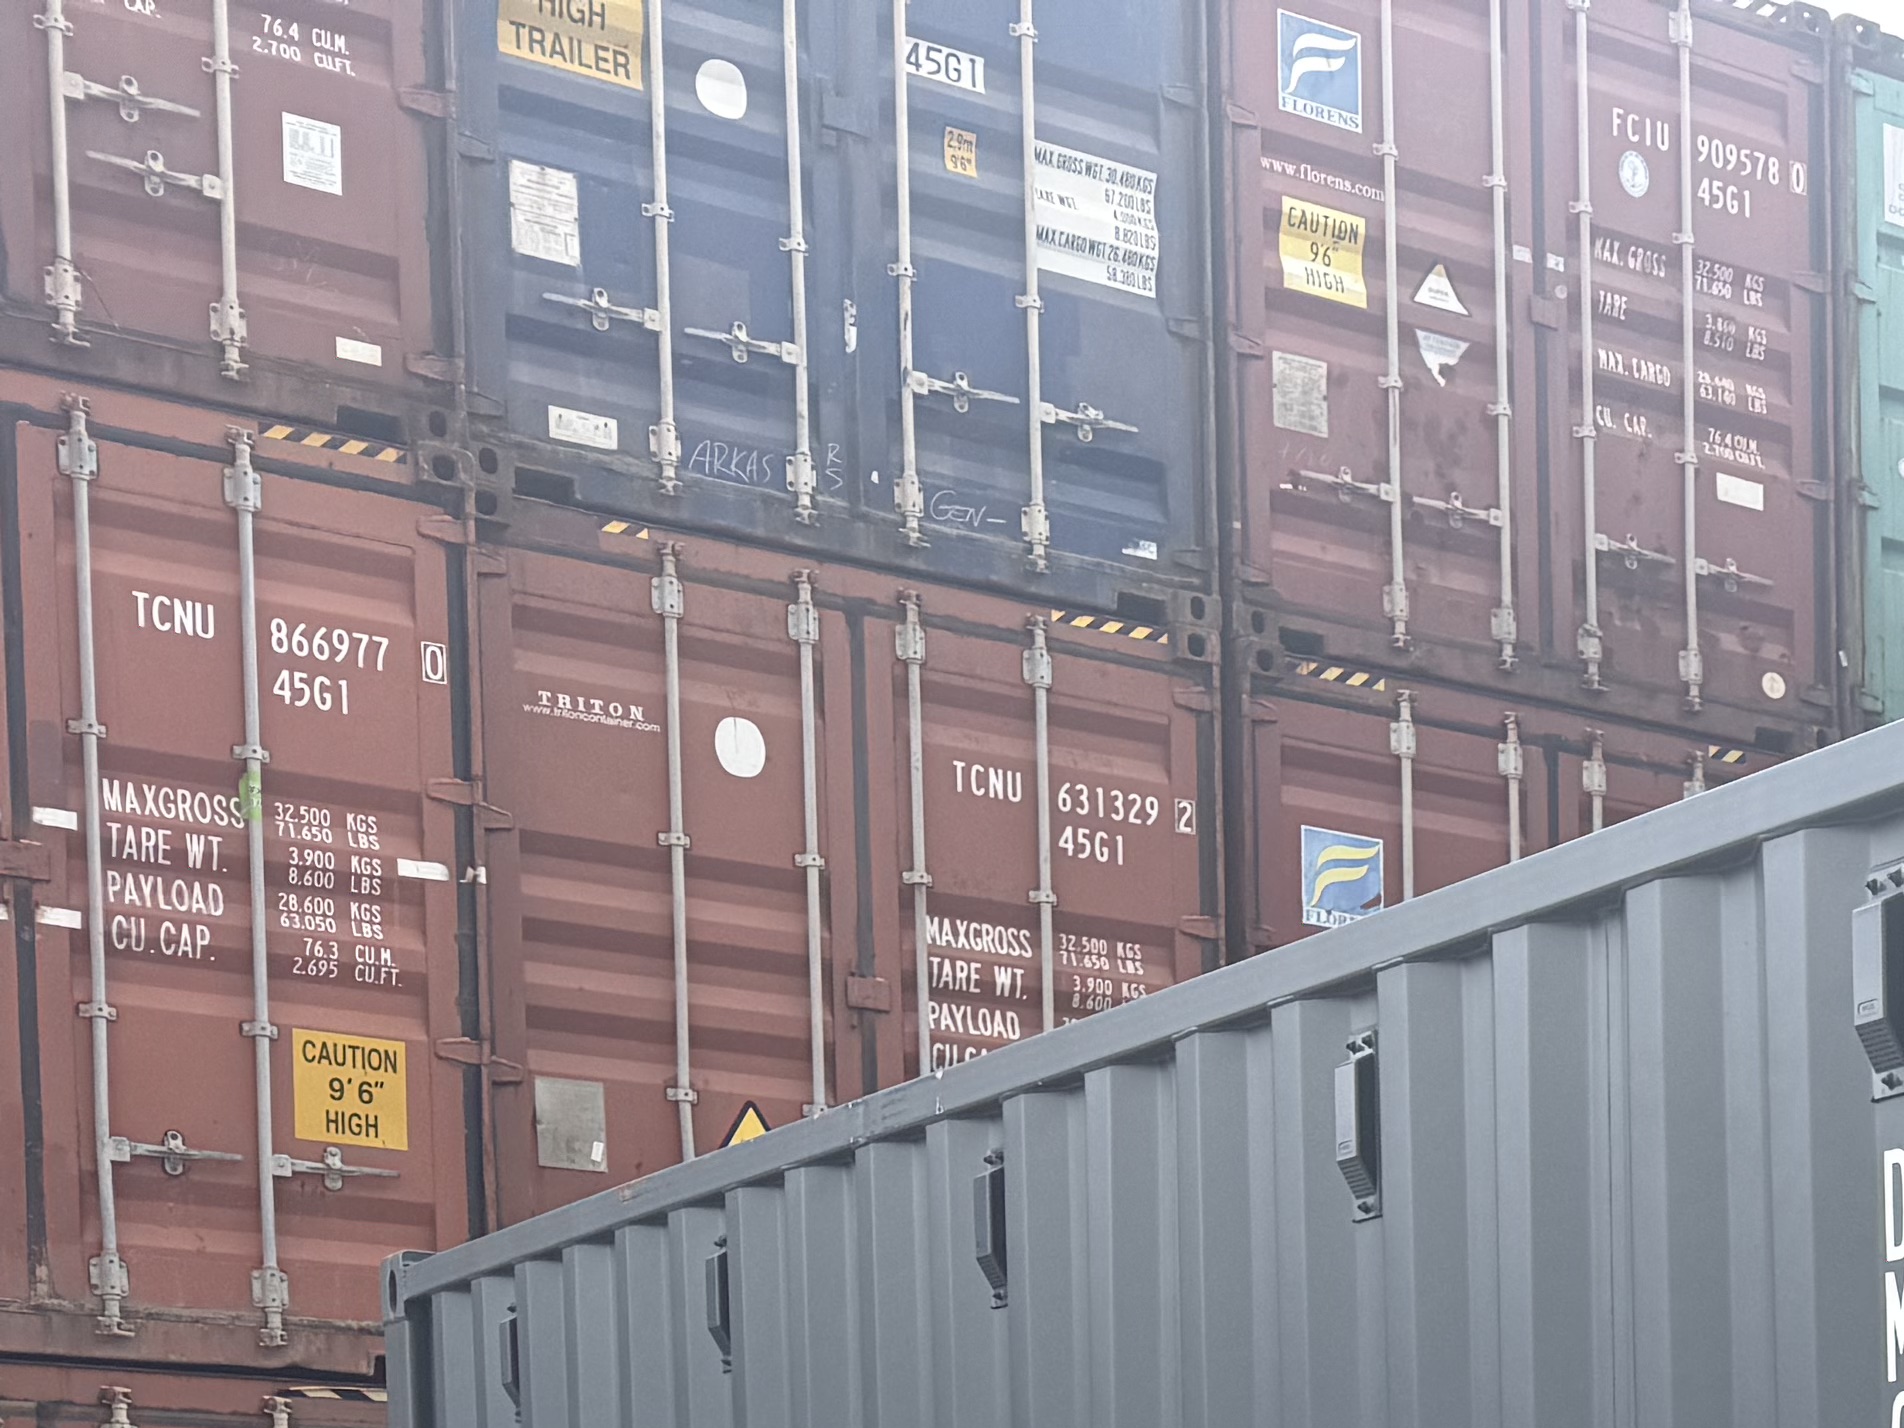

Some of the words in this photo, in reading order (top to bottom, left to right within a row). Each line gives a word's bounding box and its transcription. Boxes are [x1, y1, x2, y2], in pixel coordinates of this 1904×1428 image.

[261, 14, 299, 41] 76.4
[252, 36, 301, 61] 2.700
[509, 20, 632, 80] TRAILER
[906, 42, 977, 88] 45G1
[1281, 95, 1359, 130] FLORENS
[1612, 107, 1669, 151] FCIU
[1260, 156, 1384, 202] www.florens.com
[1697, 135, 1779, 185] 909578
[1792, 162, 1805, 194] 0
[1697, 178, 1750, 218] 45G1
[1287, 206, 1359, 245] CAUTION
[1305, 267, 1345, 293] HIGH
[1628, 247, 1666, 277] GROSS
[1599, 290, 1627, 320] TARE
[1632, 357, 1671, 387] CARGO
[688, 440, 774, 482] ARKAS
[132, 591, 215, 639] TCNU
[270, 618, 389, 671] 866977
[423, 643, 445, 682] 0
[273, 670, 348, 714] 45G1
[538, 690, 655, 721] TRITON
[953, 760, 1022, 802] TCNU
[102, 778, 245, 829] MAXGROSS
[274, 802, 331, 827] 32.500
[347, 813, 377, 834] KGS
[1058, 783, 1159, 825] 631329
[1176, 800, 1194, 833] 2
[106, 822, 171, 865] TARE
[185, 832, 227, 872] WT.
[275, 821, 332, 844] 71.650
[348, 832, 380, 850] LBS
[1058, 826, 1123, 865] 45G1
[289, 847, 334, 870] 3.900
[351, 855, 382, 876] KGS
[106, 870, 224, 916] PAYLOAD
[278, 892, 335, 916] 28.600
[350, 902, 382, 923] KGS
[303, 938, 339, 960] 76.3
[926, 915, 1032, 958] MAXGROSS
[1059, 933, 1108, 955] 32.500
[293, 957, 339, 978] 2.695
[929, 957, 981, 993] TARE
[1073, 975, 1113, 995] 3.900
[928, 1001, 1020, 1040] PAYLOAD
[302, 1039, 397, 1074] CAUTION
[325, 1109, 378, 1139] HIGH
